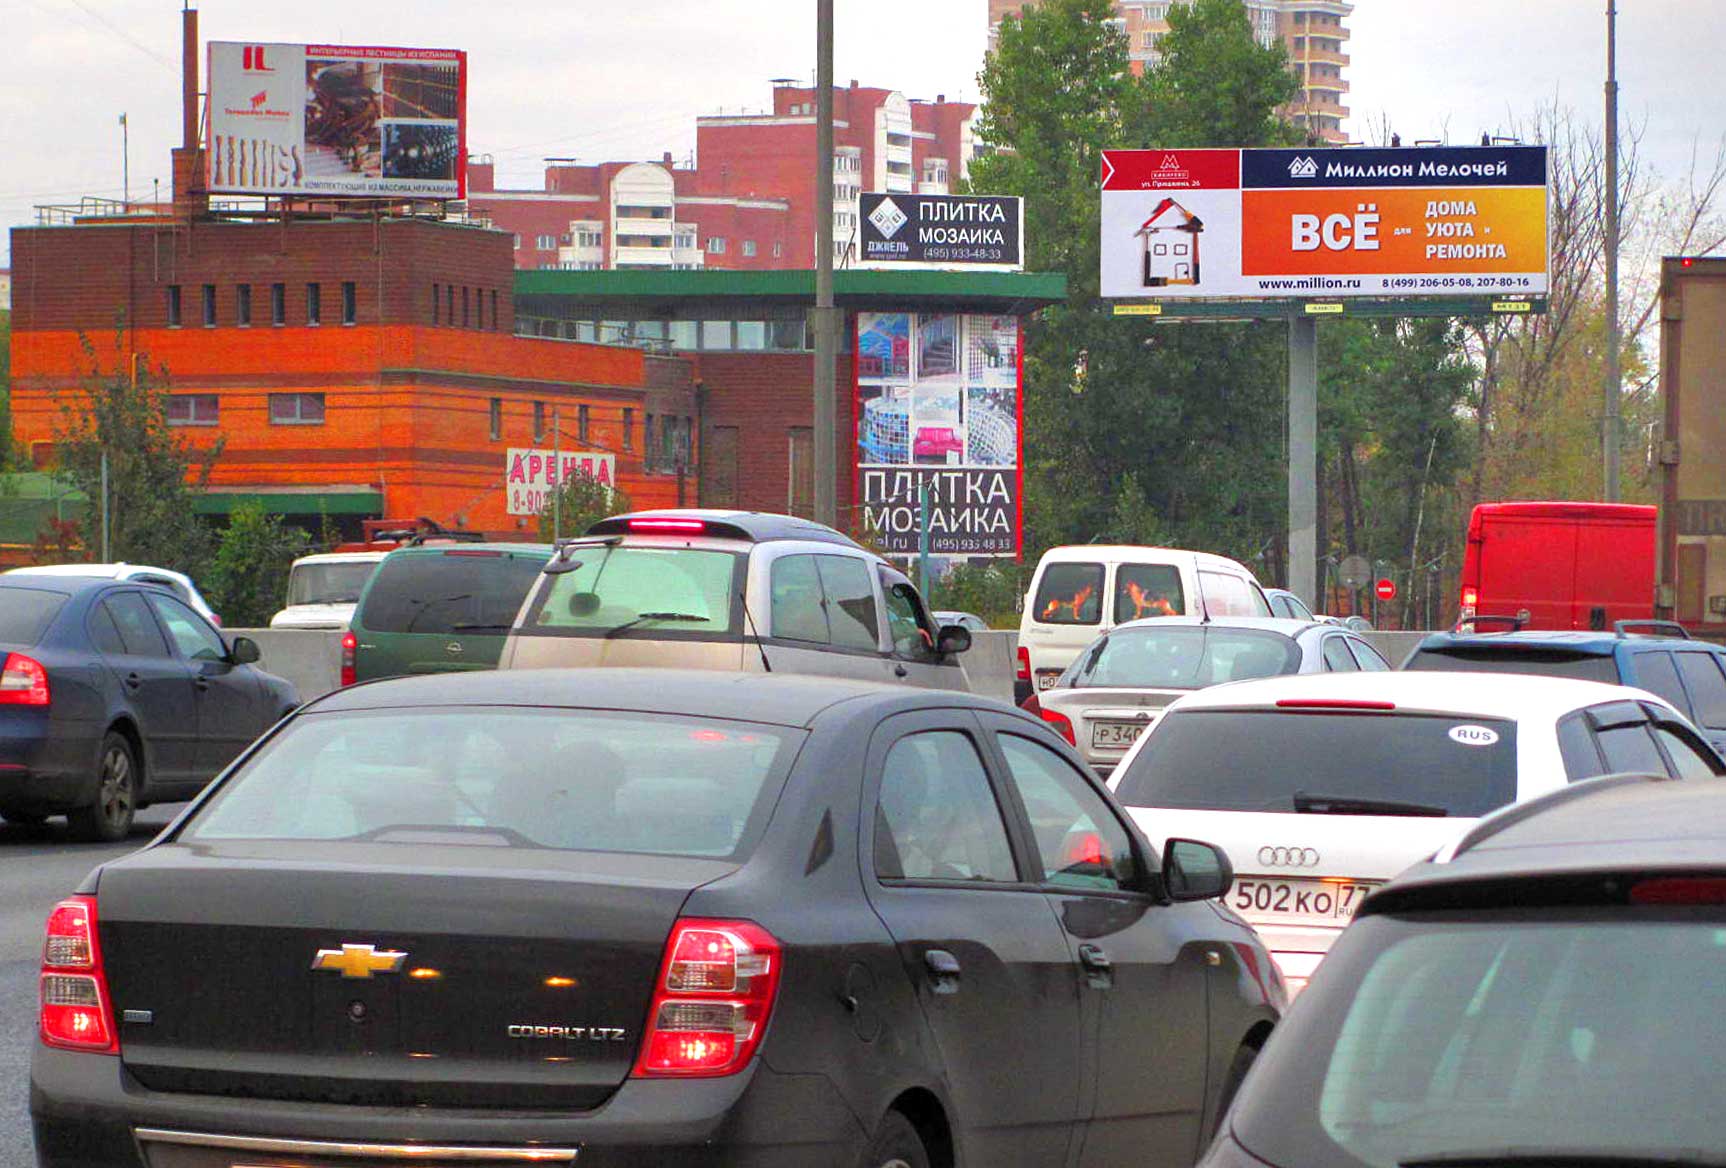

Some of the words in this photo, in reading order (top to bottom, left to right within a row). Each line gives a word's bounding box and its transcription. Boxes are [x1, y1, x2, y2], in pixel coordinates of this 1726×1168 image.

[1325, 163, 1413, 178] Миллион
[1418, 160, 1507, 177] Мелочей
[919, 202, 1006, 222] ПЛИТКА
[1425, 201, 1477, 218] ДОМА
[1291, 203, 1381, 251] ВСЁ
[1425, 222, 1475, 238] УЮТА
[919, 227, 1004, 245] МОЗАИКА
[923, 247, 949, 260] (495)
[951, 247, 1001, 260] 933-48-33
[1425, 244, 1507, 259] РЕМОНТА
[1259, 277, 1361, 290] www.million.ru
[1382, 278, 1389, 288] 8
[1391, 278, 1418, 290] (499)
[1420, 277, 1475, 289] 206-05-08,
[1477, 276, 1530, 287] 207-80-16
[864, 471, 1011, 504] ПЛИТКА
[933, 538, 959, 551] (495)
[1457, 729, 1491, 741] RUS
[508, 1024, 585, 1040] COBALT
[590, 1027, 625, 1041] LTZ
